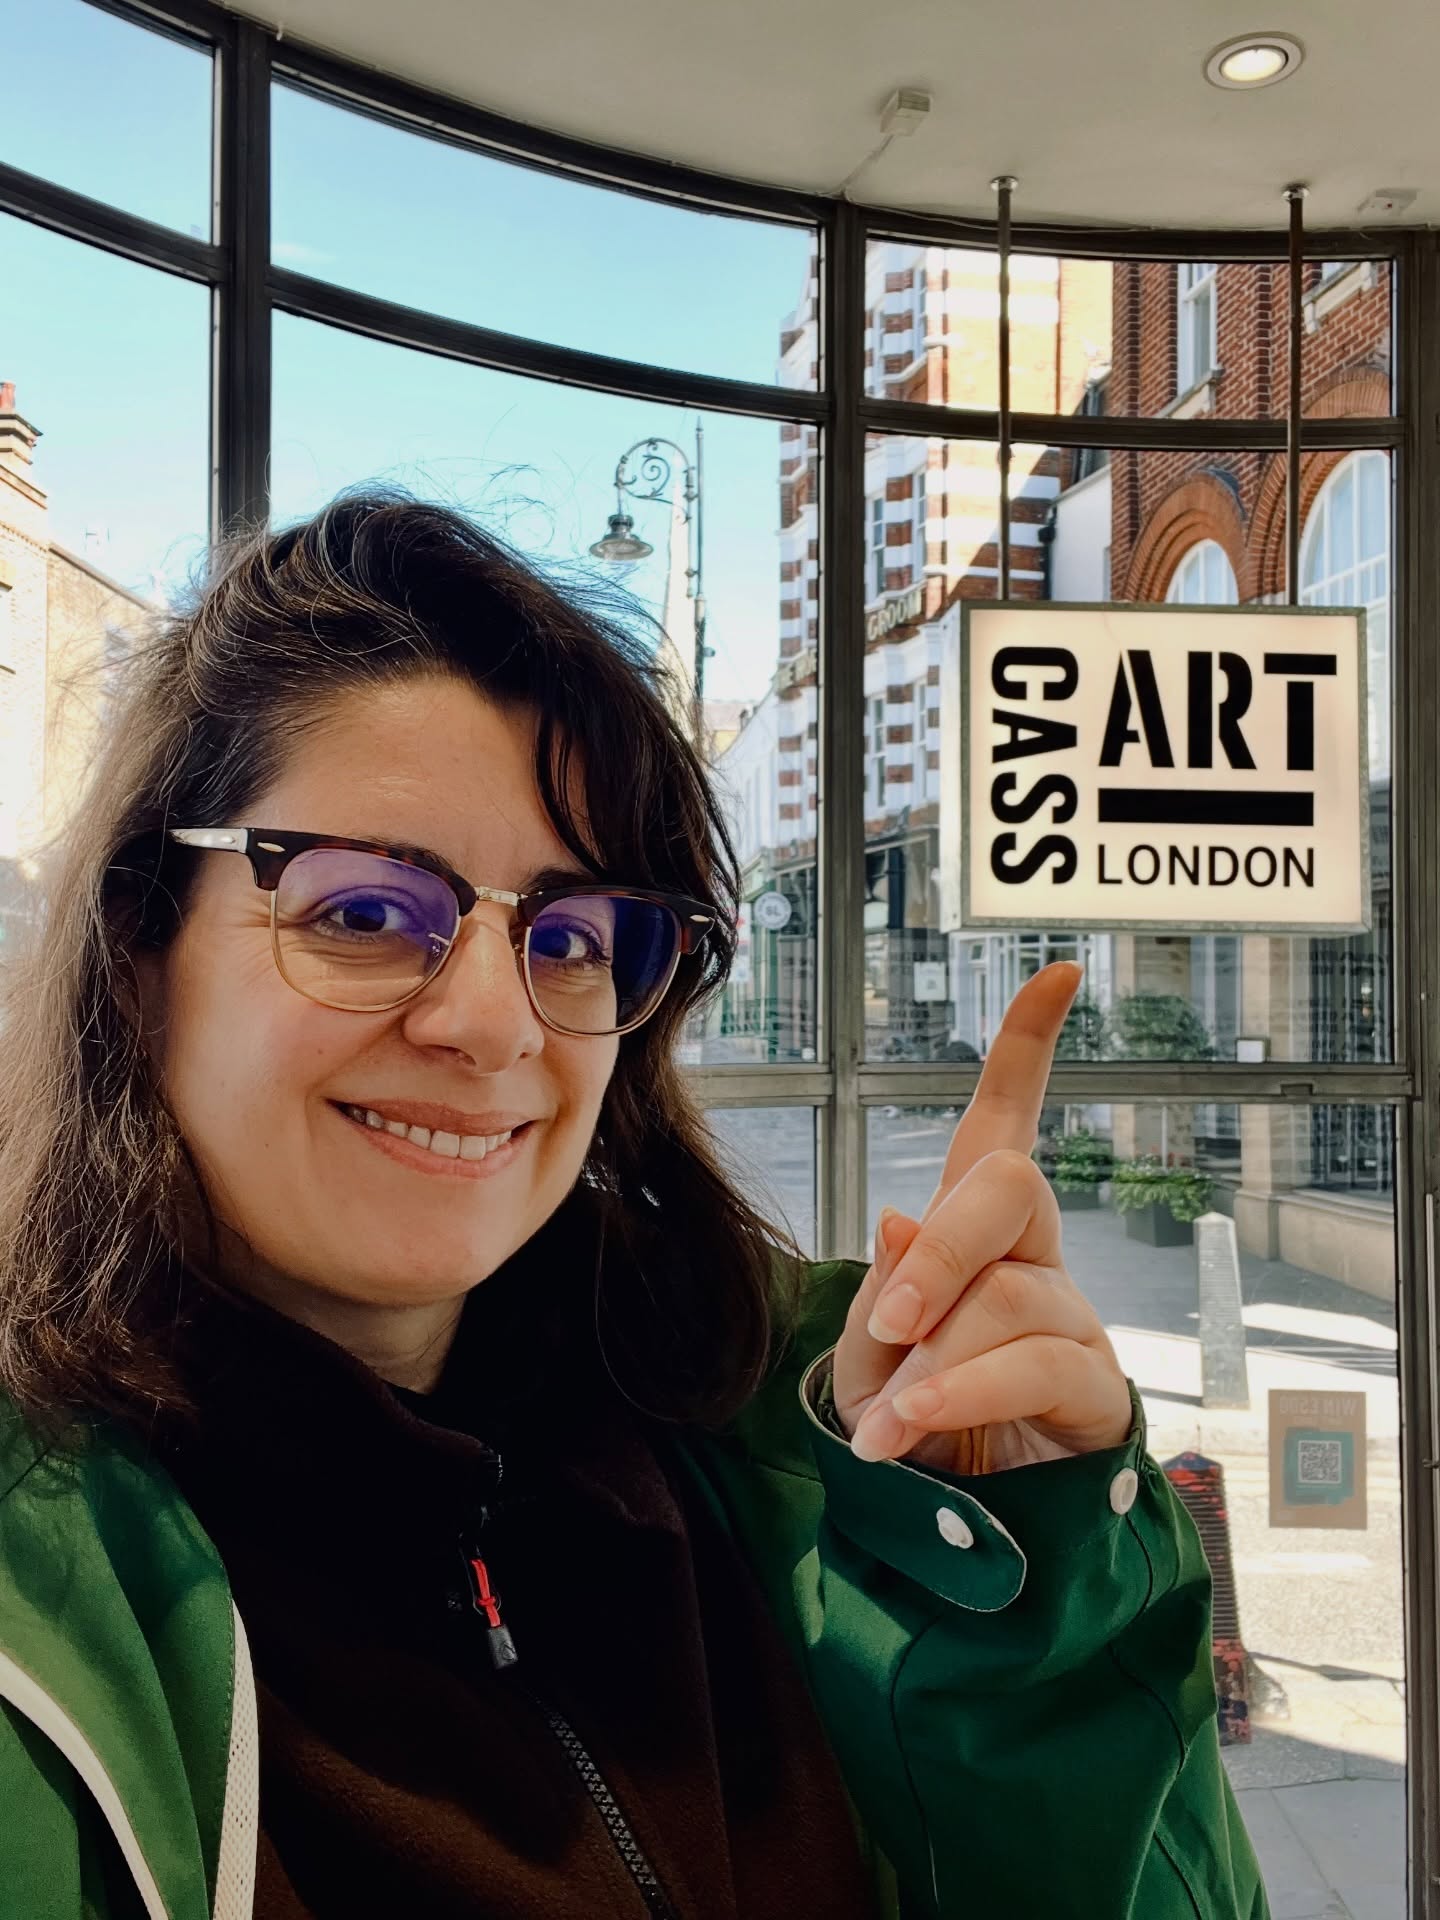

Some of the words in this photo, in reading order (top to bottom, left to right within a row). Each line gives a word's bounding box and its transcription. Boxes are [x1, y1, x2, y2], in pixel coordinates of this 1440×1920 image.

[867, 589, 921, 641] GROOM
[1098, 649, 1337, 771] ART
[991, 646, 1079, 884] CASS
[1098, 844, 1314, 888] LONDON
